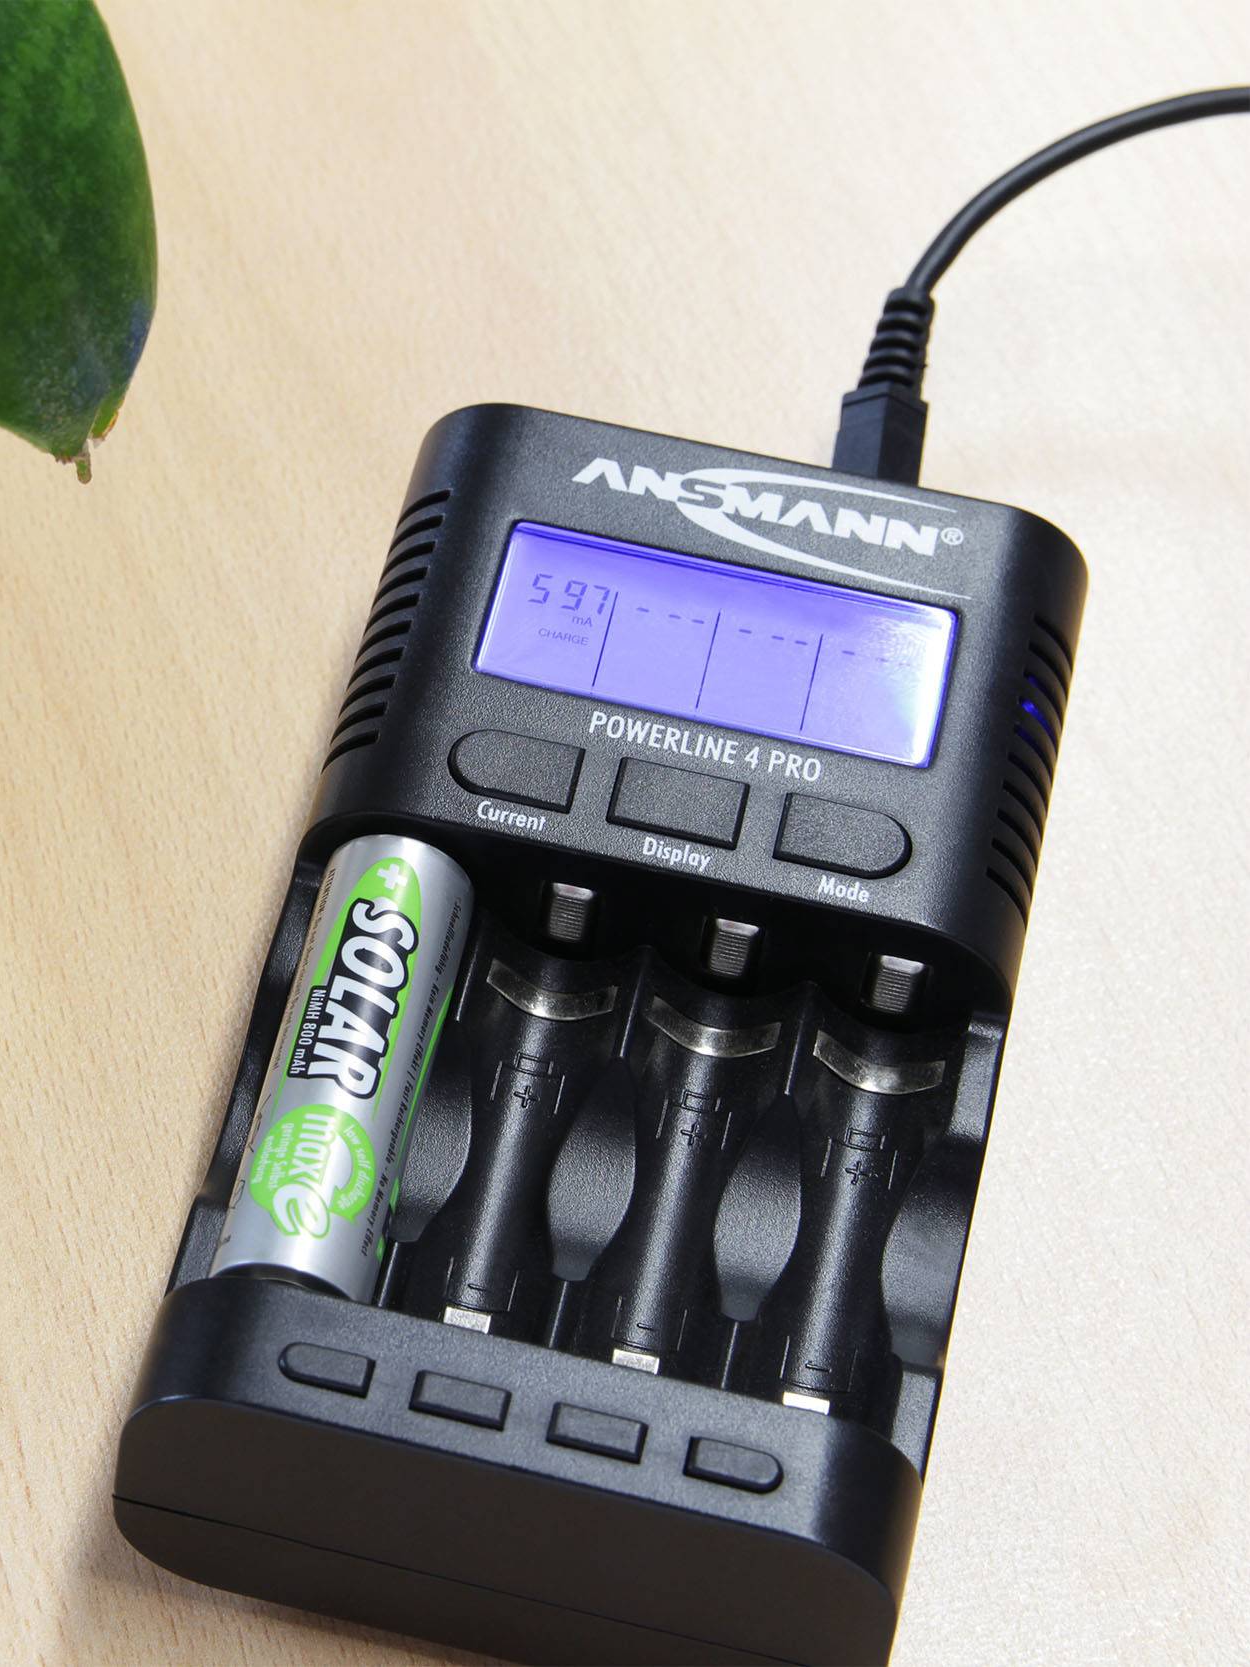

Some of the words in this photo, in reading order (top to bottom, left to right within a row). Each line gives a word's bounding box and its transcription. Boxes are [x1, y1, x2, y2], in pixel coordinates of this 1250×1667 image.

[538, 627, 589, 646] CHARGE
[571, 614, 594, 628] mA
[589, 711, 739, 764] POWERLINE
[744, 747, 760, 770] 4
[768, 750, 822, 783] PRO
[477, 800, 547, 832] Current
[642, 837, 713, 872] Display
[818, 874, 871, 904] Mode
[305, 989, 327, 1019] NiMH
[309, 901, 417, 1097] SOLAR
[298, 1022, 317, 1046] 800
[416, 1004, 434, 1042] Memory
[289, 1048, 307, 1075] mAh
[401, 1080, 414, 1102] Fast
[344, 1124, 363, 1142] low
[355, 1144, 371, 1169] self
[365, 1187, 383, 1227] Memory
